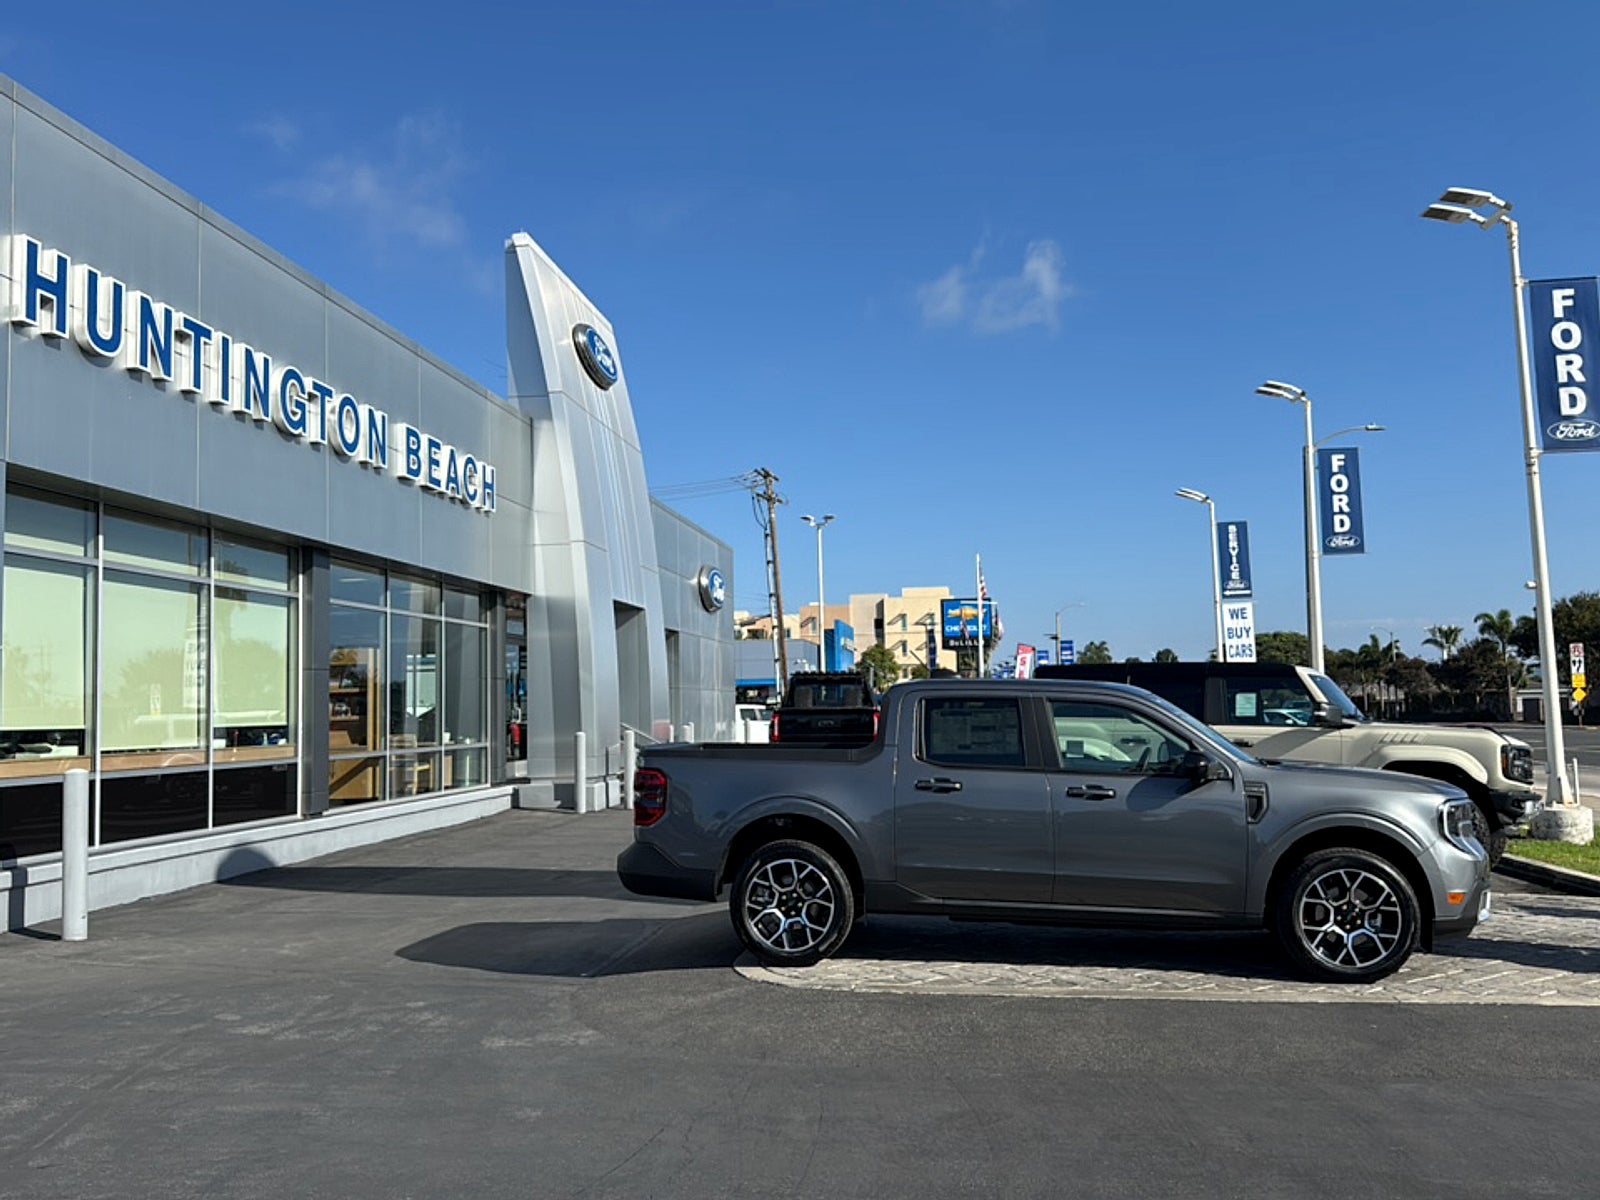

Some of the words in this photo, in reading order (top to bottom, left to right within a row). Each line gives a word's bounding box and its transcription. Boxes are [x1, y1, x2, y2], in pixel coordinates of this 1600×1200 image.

[1551, 287, 1587, 417] FORD
[14, 234, 388, 470] HUNTINGTON
[398, 423, 497, 513] BEACH
[1556, 422, 1595, 440] Ford
[1329, 453, 1351, 533] FORD
[1228, 524, 1241, 580] SERVICE
[1228, 607, 1249, 620] WE
[945, 624, 988, 632] CHEOLT
[1226, 626, 1252, 640] BUY
[1228, 643, 1254, 658] CARS
